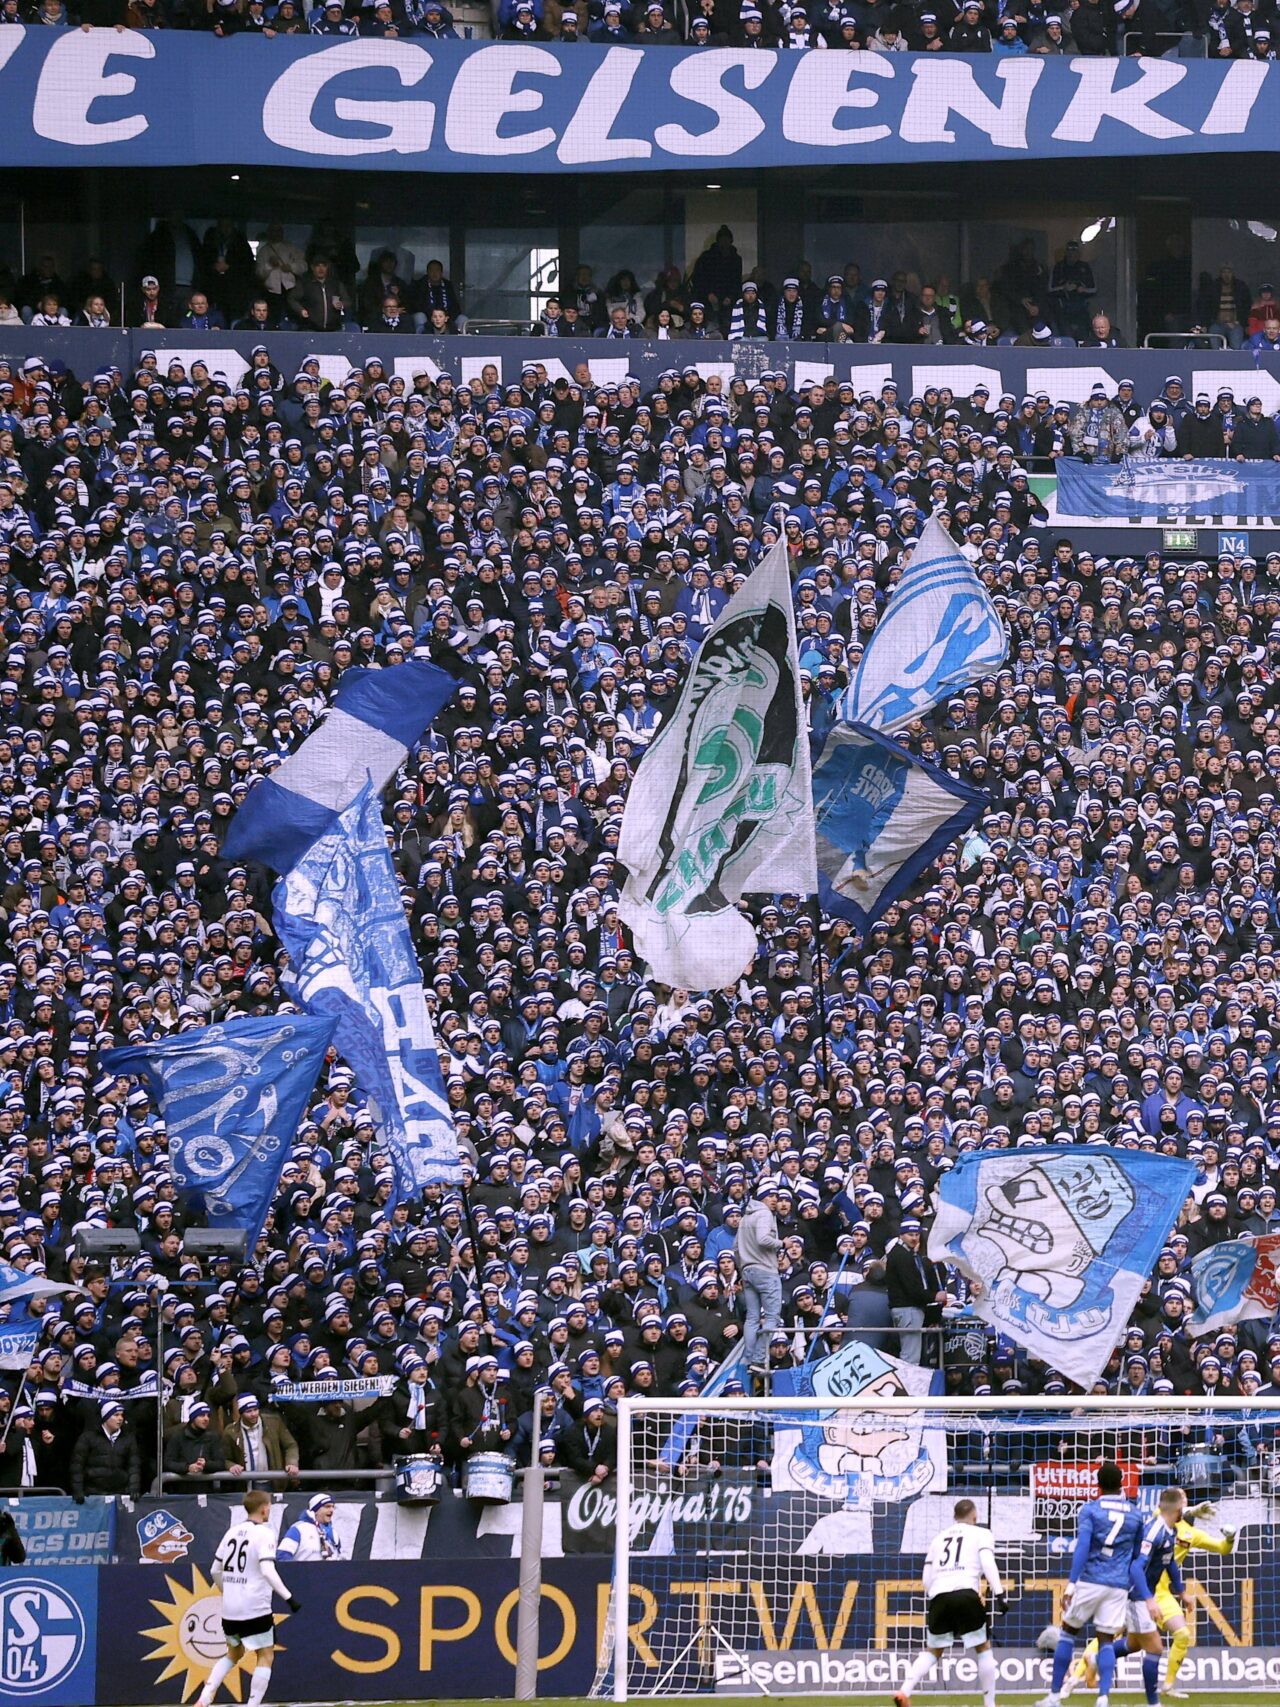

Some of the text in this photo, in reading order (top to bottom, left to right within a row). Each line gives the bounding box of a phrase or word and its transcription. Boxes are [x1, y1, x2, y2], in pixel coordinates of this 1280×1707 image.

[0, 26, 156, 145] E
[1222, 536, 1245, 553] N4
[0, 1334, 37, 1353] OYZ
[301, 1381, 338, 1394] WERDEN
[344, 1378, 380, 1392] SIEGEN!
[567, 1482, 720, 1543] Orginal
[1104, 1510, 1125, 1546] 7
[224, 1538, 249, 1573] 26
[940, 1536, 964, 1566] 31
[715, 1653, 910, 1686] Eisenbach
